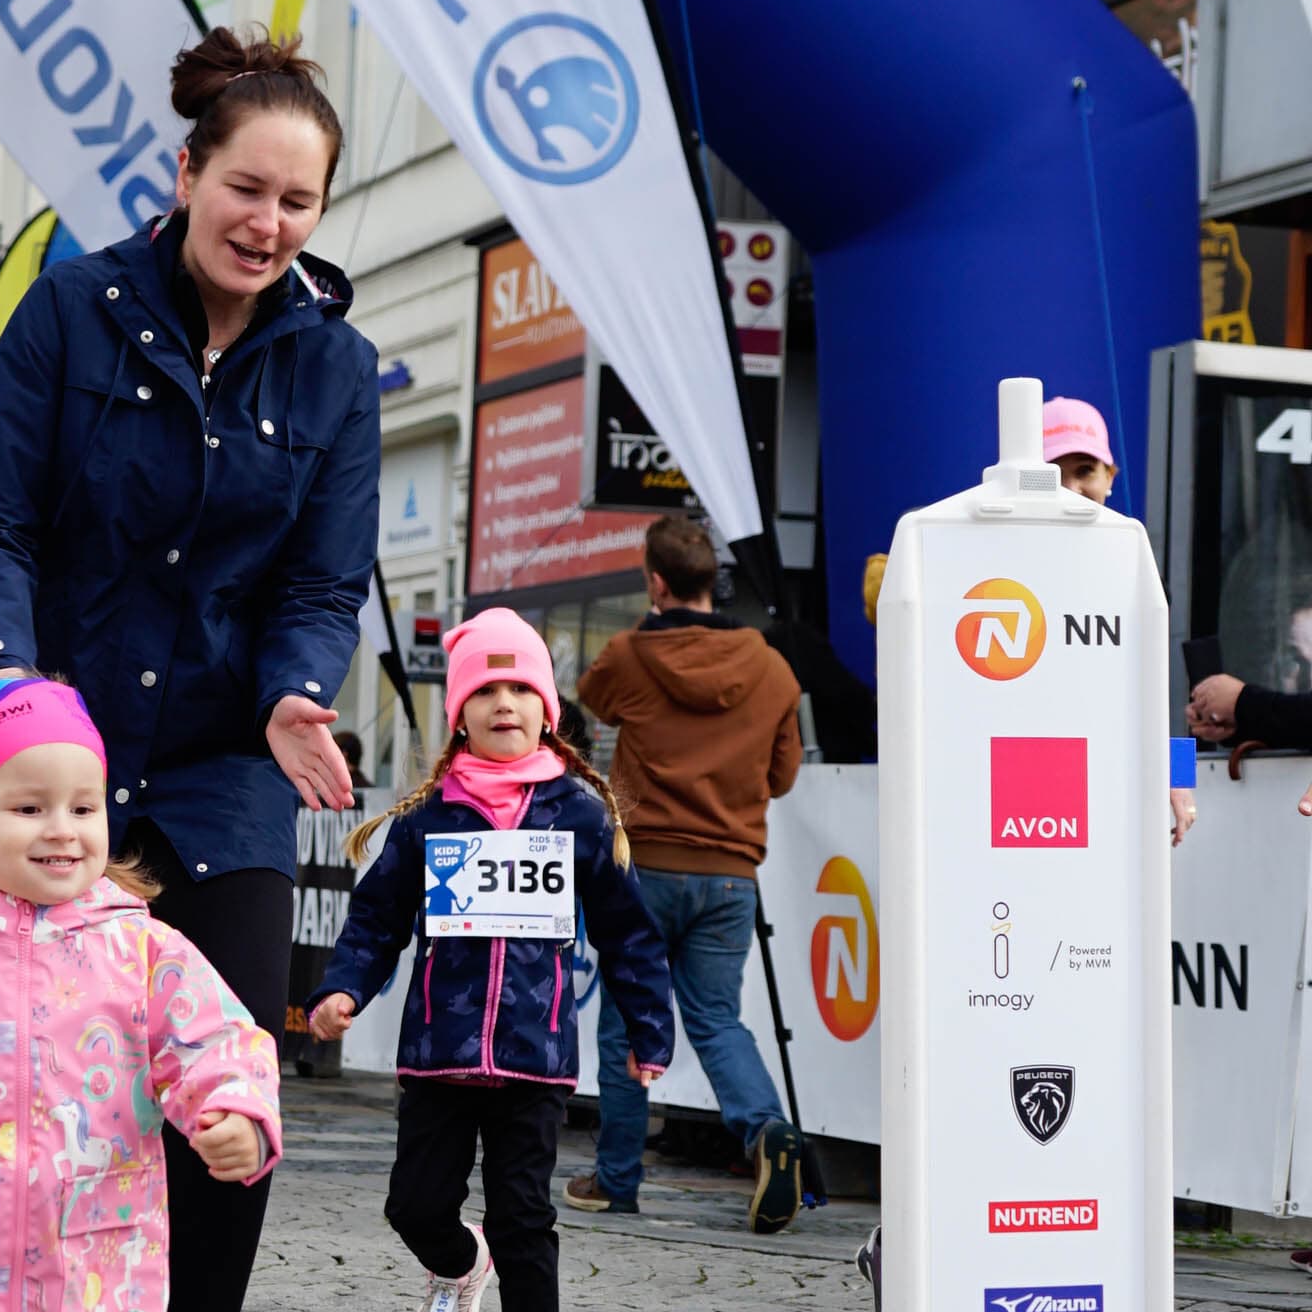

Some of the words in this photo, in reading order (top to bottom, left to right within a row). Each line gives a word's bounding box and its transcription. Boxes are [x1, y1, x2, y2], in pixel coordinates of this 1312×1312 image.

[492, 262, 567, 330] SLAV
[1064, 614, 1121, 646] NN
[1001, 817, 1078, 839] AVON
[529, 835, 550, 844] KIDS
[434, 845, 461, 857] KIDS
[529, 845, 548, 853] CUP
[435, 857, 459, 867] CUP
[477, 859, 565, 894] 3136
[1069, 946, 1112, 956] Powered
[1069, 960, 1082, 969] by
[1086, 959, 1112, 969] MVM
[968, 989, 1034, 1011] innogy
[1016, 1071, 1070, 1081] PEUGEOT
[994, 1205, 1094, 1227] NUTREND
